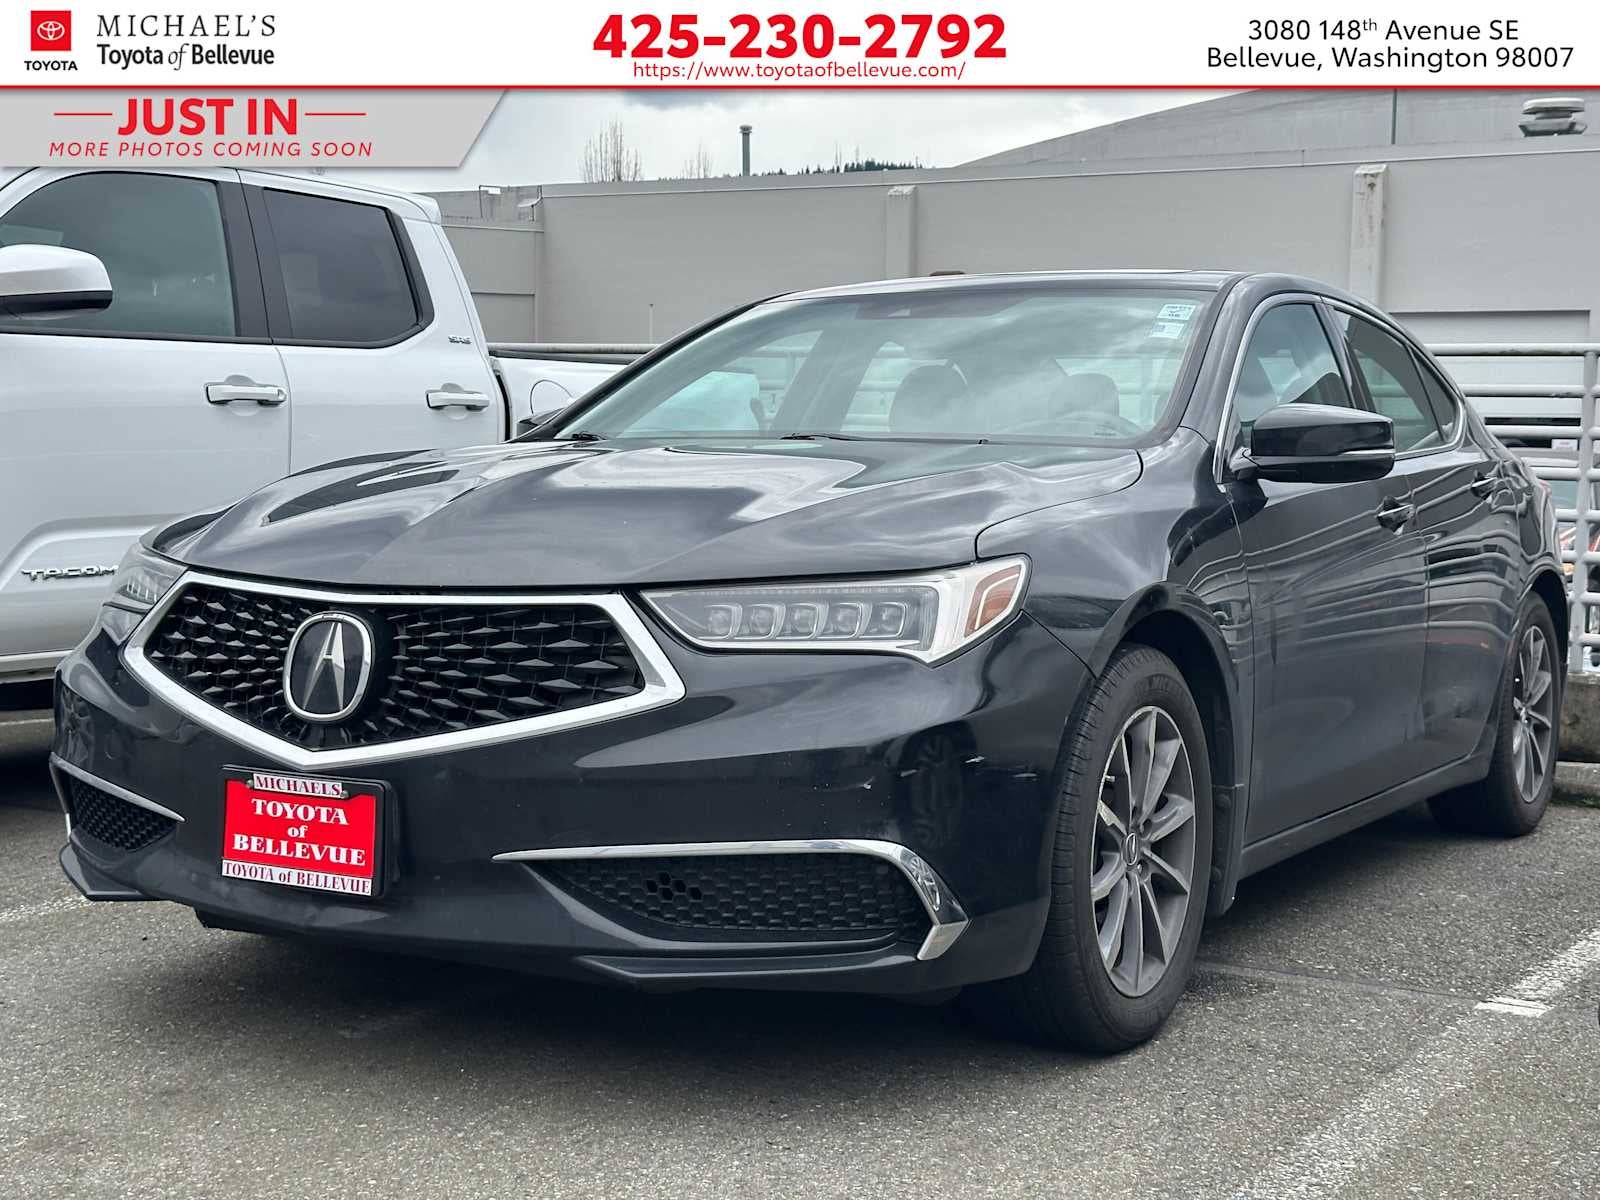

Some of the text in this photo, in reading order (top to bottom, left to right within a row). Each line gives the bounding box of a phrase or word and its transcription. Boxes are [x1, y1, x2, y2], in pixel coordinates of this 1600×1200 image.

[21, 565, 119, 582] TACOM
[255, 776, 341, 796] MICHAELS
[252, 798, 348, 825] TOYOTA
[287, 825, 308, 839] of
[233, 834, 365, 865] BELLEVUE
[224, 861, 370, 894] TOYOTA of BELLEVUE
